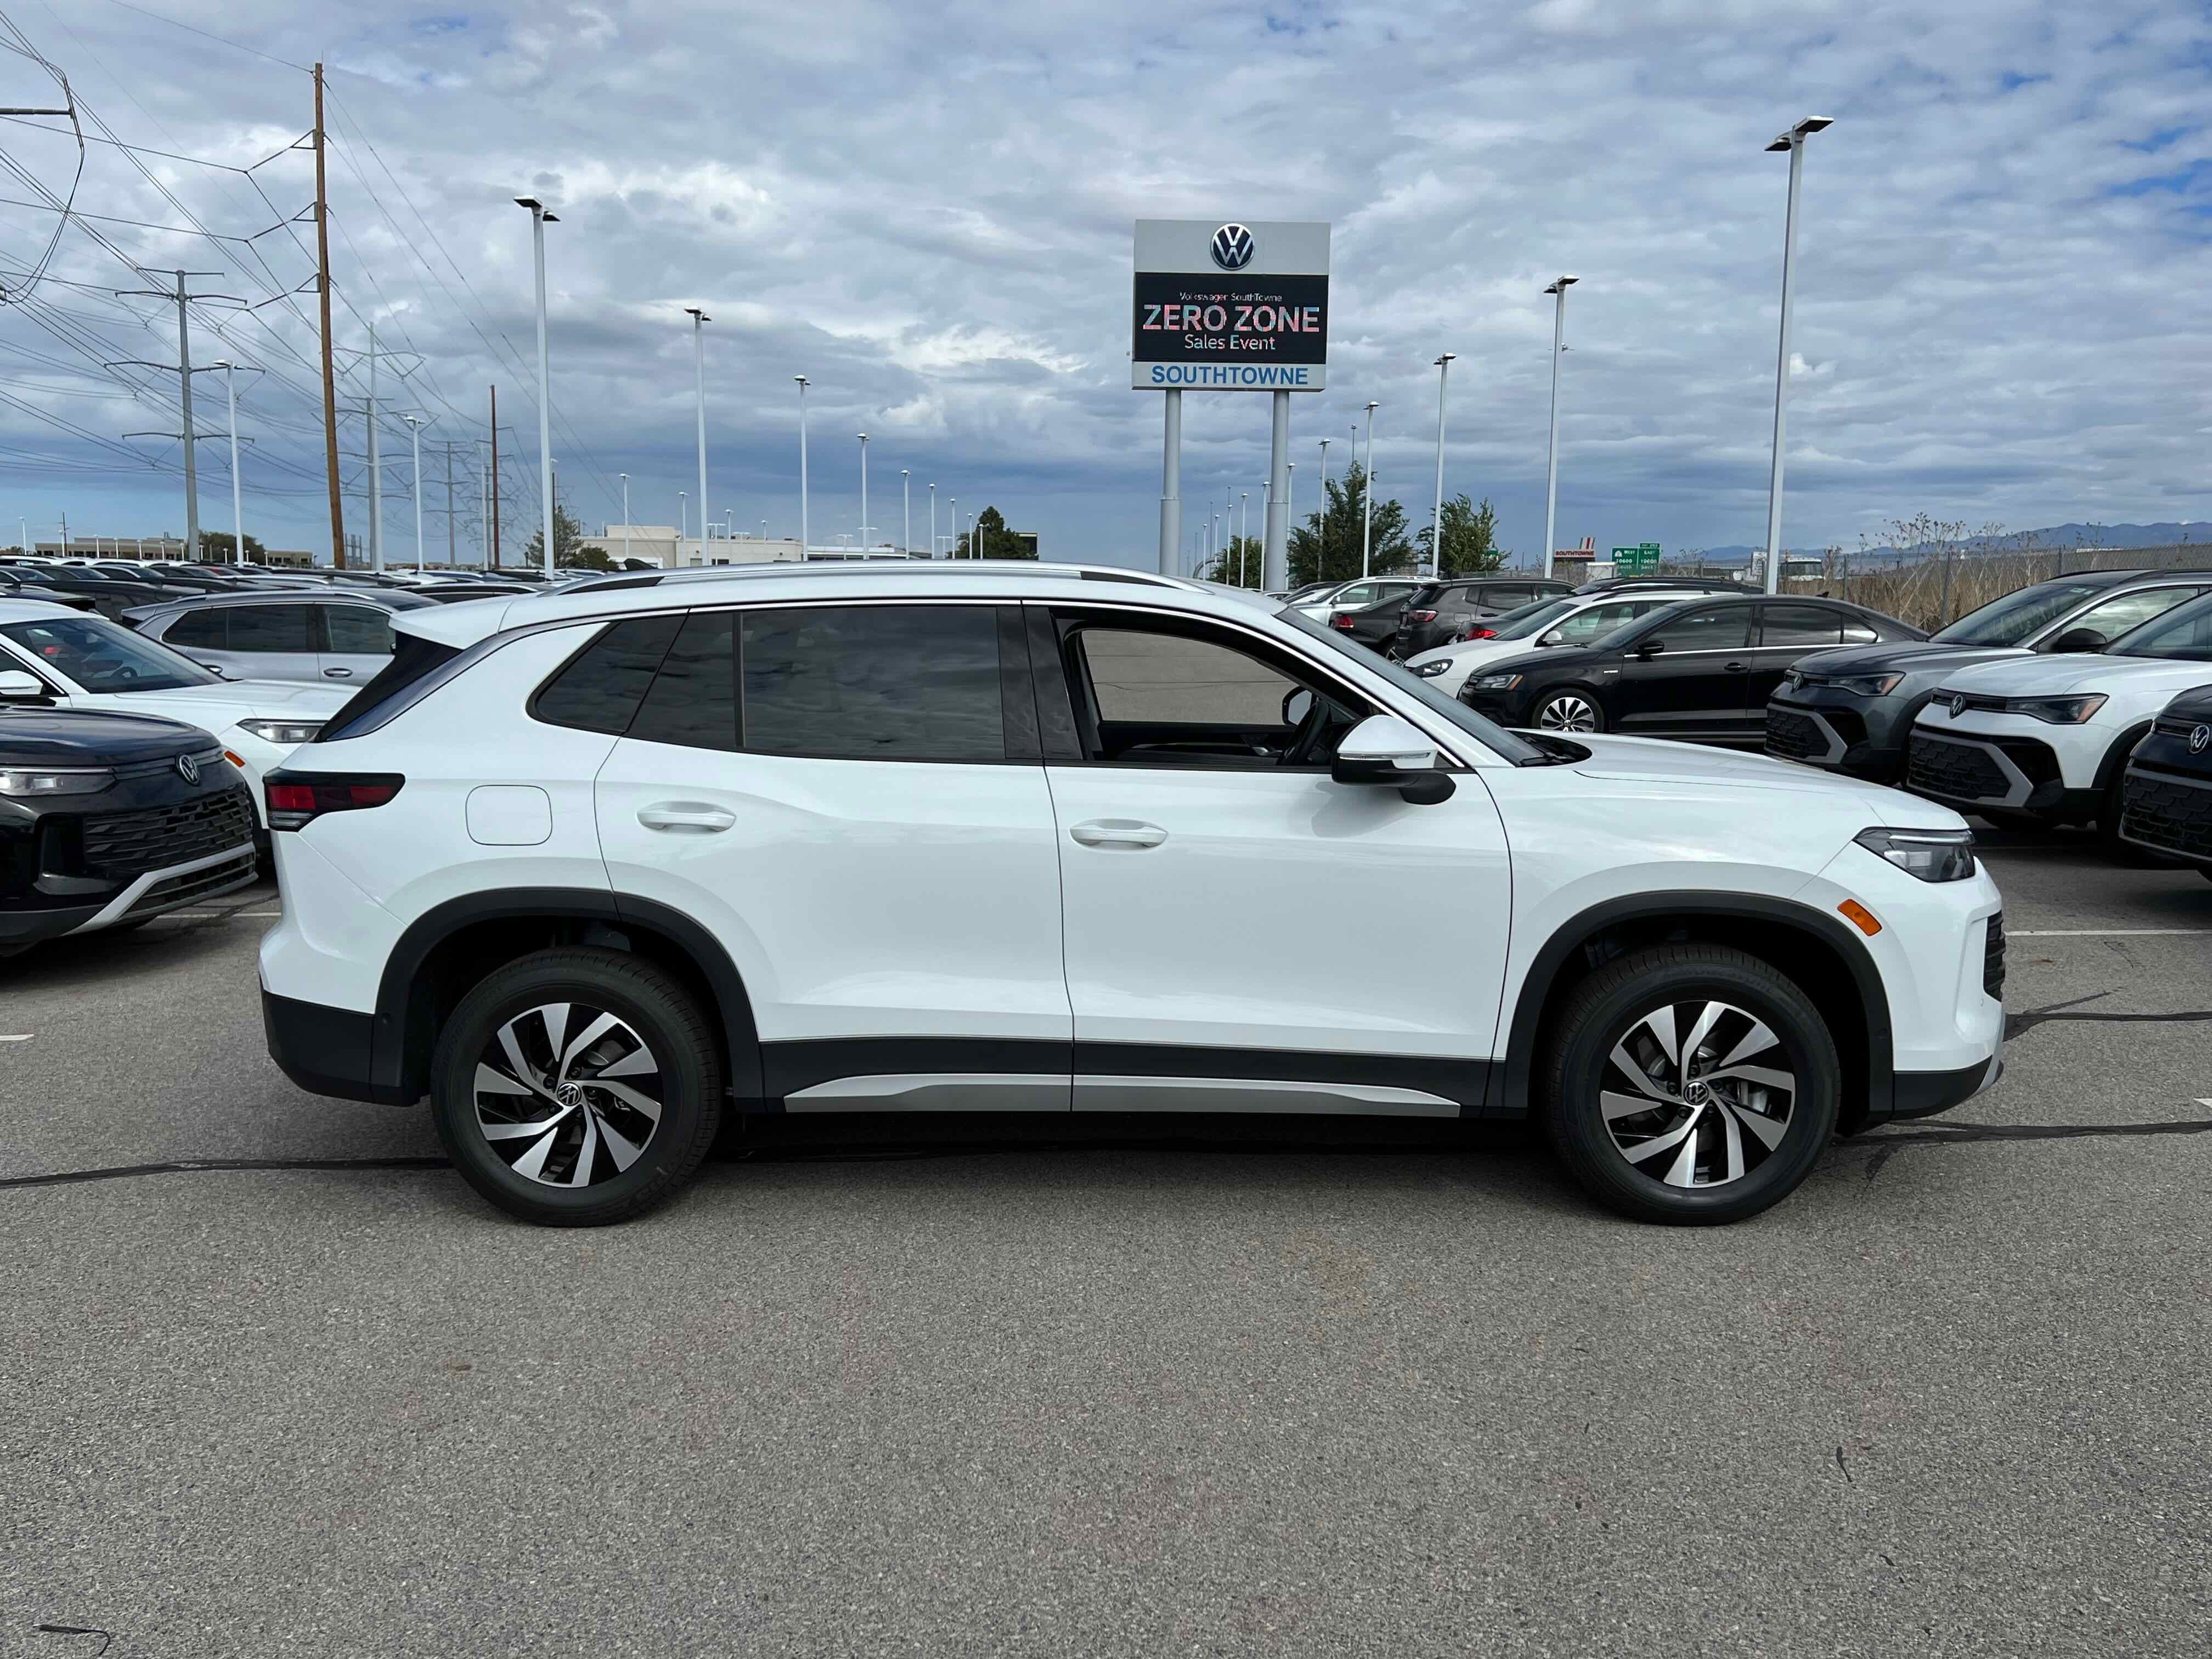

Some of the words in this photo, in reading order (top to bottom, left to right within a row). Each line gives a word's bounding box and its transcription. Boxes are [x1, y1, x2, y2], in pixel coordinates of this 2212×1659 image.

[1143, 304, 1227, 331] ZERO
[1234, 305, 1319, 332] ZONE
[1184, 334, 1225, 350] Sales
[1230, 334, 1276, 350] Event
[1152, 365, 1308, 385] SOUTHTOWNE
